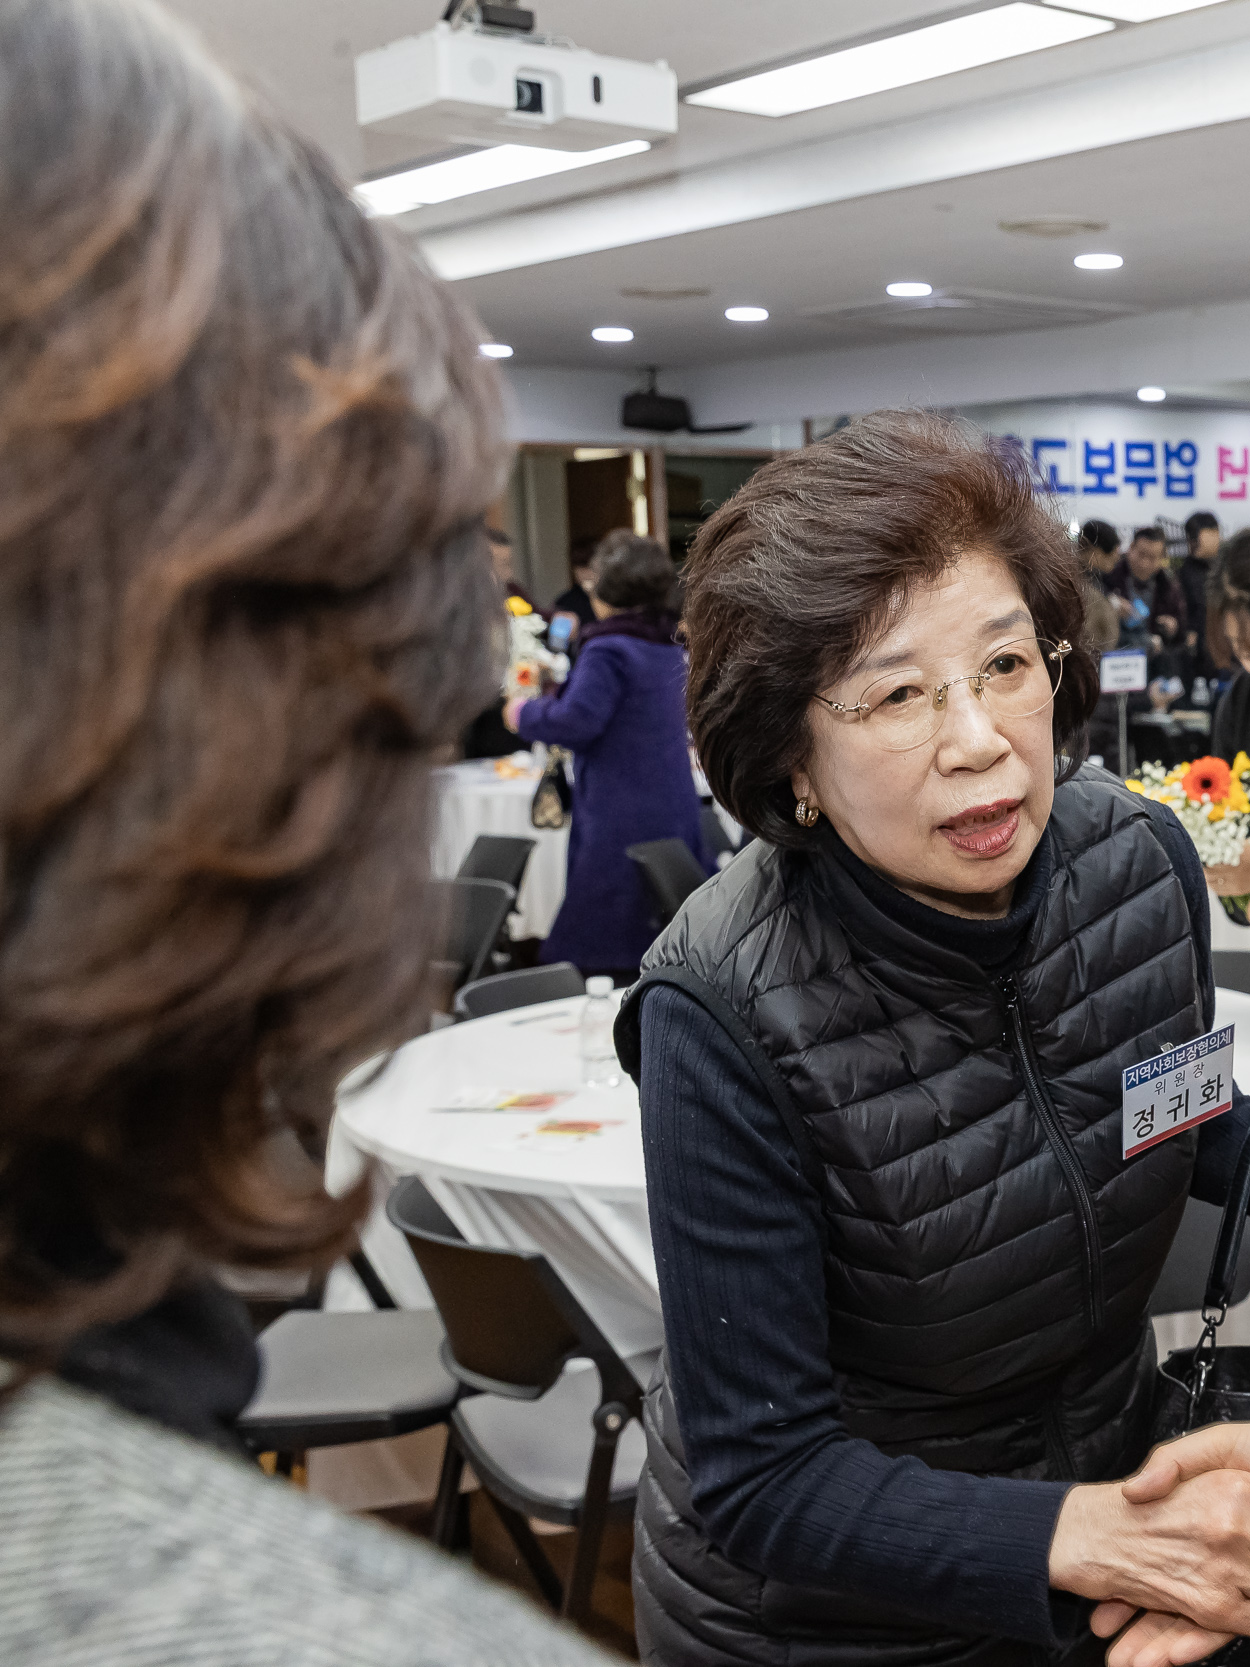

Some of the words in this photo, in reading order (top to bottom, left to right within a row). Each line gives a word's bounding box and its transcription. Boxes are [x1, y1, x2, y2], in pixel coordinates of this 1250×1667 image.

[1127, 1028, 1231, 1086] 지역사회보장협의체
[1154, 1062, 1205, 1095] 위원장
[1132, 1073, 1224, 1139] 정귀화
